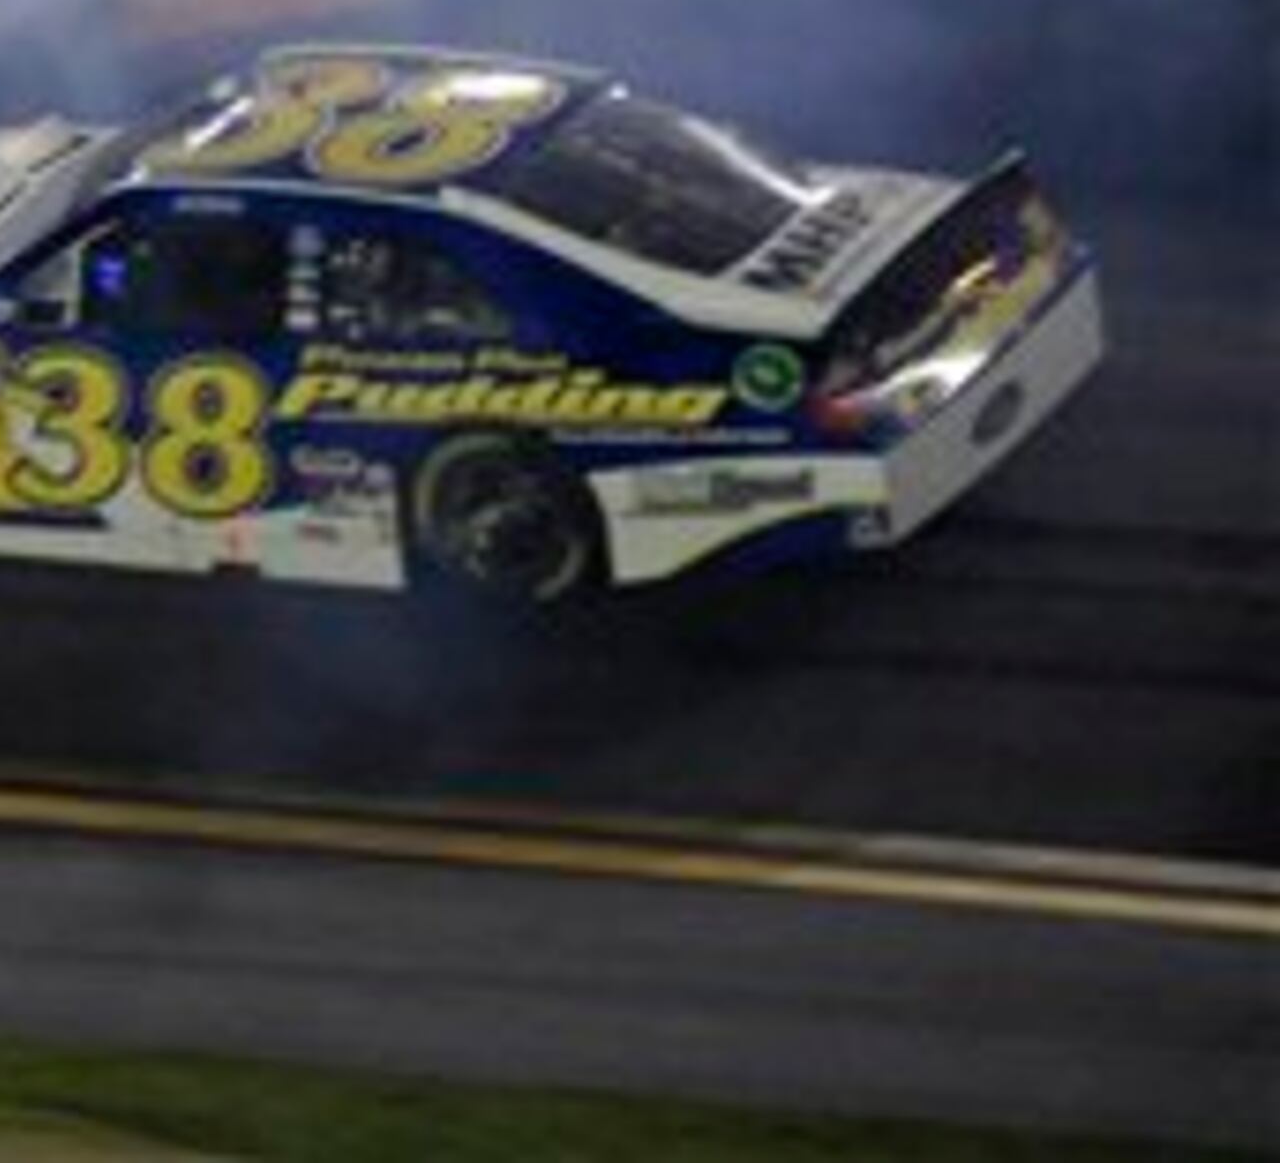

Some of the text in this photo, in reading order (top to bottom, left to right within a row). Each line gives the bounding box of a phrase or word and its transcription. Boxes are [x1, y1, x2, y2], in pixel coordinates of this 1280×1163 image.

[140, 58, 568, 186] 38
[2, 343, 274, 518] 38
[274, 366, 731, 426] Pudding
